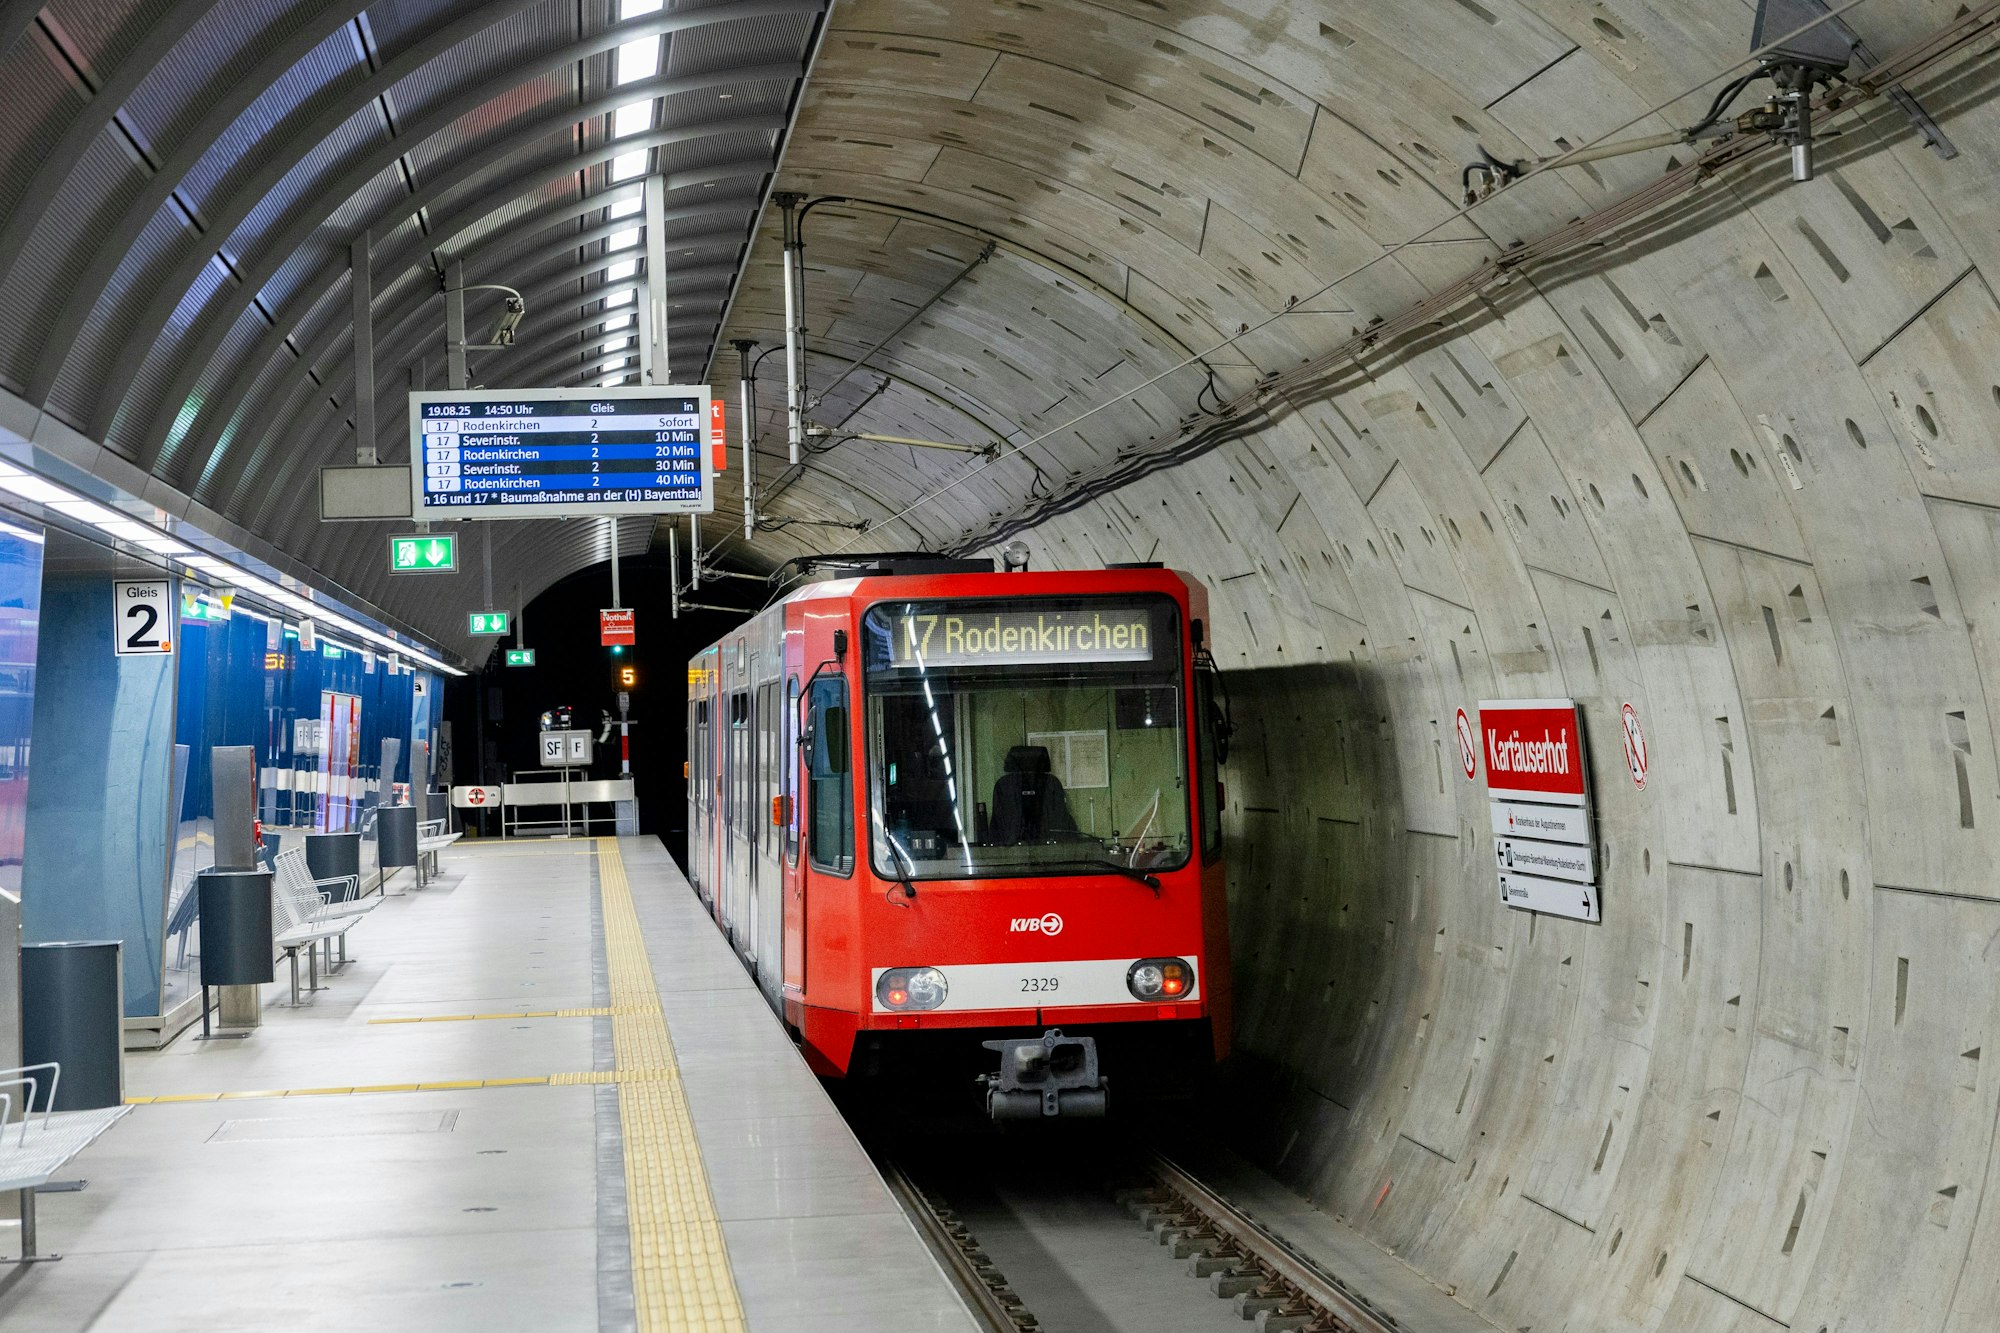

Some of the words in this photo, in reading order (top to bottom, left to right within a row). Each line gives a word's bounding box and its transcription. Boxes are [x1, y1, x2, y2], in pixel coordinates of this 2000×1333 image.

[428, 406, 471, 416] 19.08.25
[486, 405, 512, 415] 14:50
[515, 405, 534, 415] Uhr
[590, 403, 615, 413] Gleis
[684, 402, 693, 411] in
[436, 422, 449, 431] 17
[463, 419, 540, 431] Rodenkirchen
[591, 419, 598, 428] 2
[659, 417, 693, 427] Sofort
[437, 436, 450, 446] 17
[463, 434, 520, 446] Severinstr.
[591, 433, 599, 443] 2
[655, 432, 669, 442] 10
[672, 431, 693, 441] Min
[437, 451, 450, 460] 17
[463, 448, 539, 460] Rodenkirchen
[591, 447, 599, 458] 2
[655, 446, 670, 457] 20
[672, 446, 694, 456] Min
[437, 466, 450, 475] 17
[463, 463, 521, 475] Severinstr.
[592, 462, 600, 472] 2
[655, 460, 670, 471] 30
[673, 460, 694, 470] Min
[438, 480, 451, 490] 17
[464, 477, 540, 490] Rodenkirchen
[592, 476, 600, 487] 2
[655, 475, 670, 485] 40
[673, 474, 695, 484] Min
[433, 494, 447, 505] 16
[450, 493, 471, 504] und
[474, 493, 487, 503] 17
[500, 490, 585, 503] Baumaßnahme
[587, 491, 600, 501] an
[603, 490, 622, 501] der
[625, 489, 641, 501] (H)
[127, 587, 157, 598] Gleis
[127, 604, 159, 648] 2
[901, 614, 938, 660] 17
[946, 613, 1147, 653] Rodenkirchen
[623, 668, 634, 685] 5
[547, 741, 561, 756] SF
[575, 742, 581, 752] F
[1487, 728, 1569, 774] Kartäuserhof
[1010, 918, 1040, 932] KVB
[1021, 977, 1059, 992] 2329
